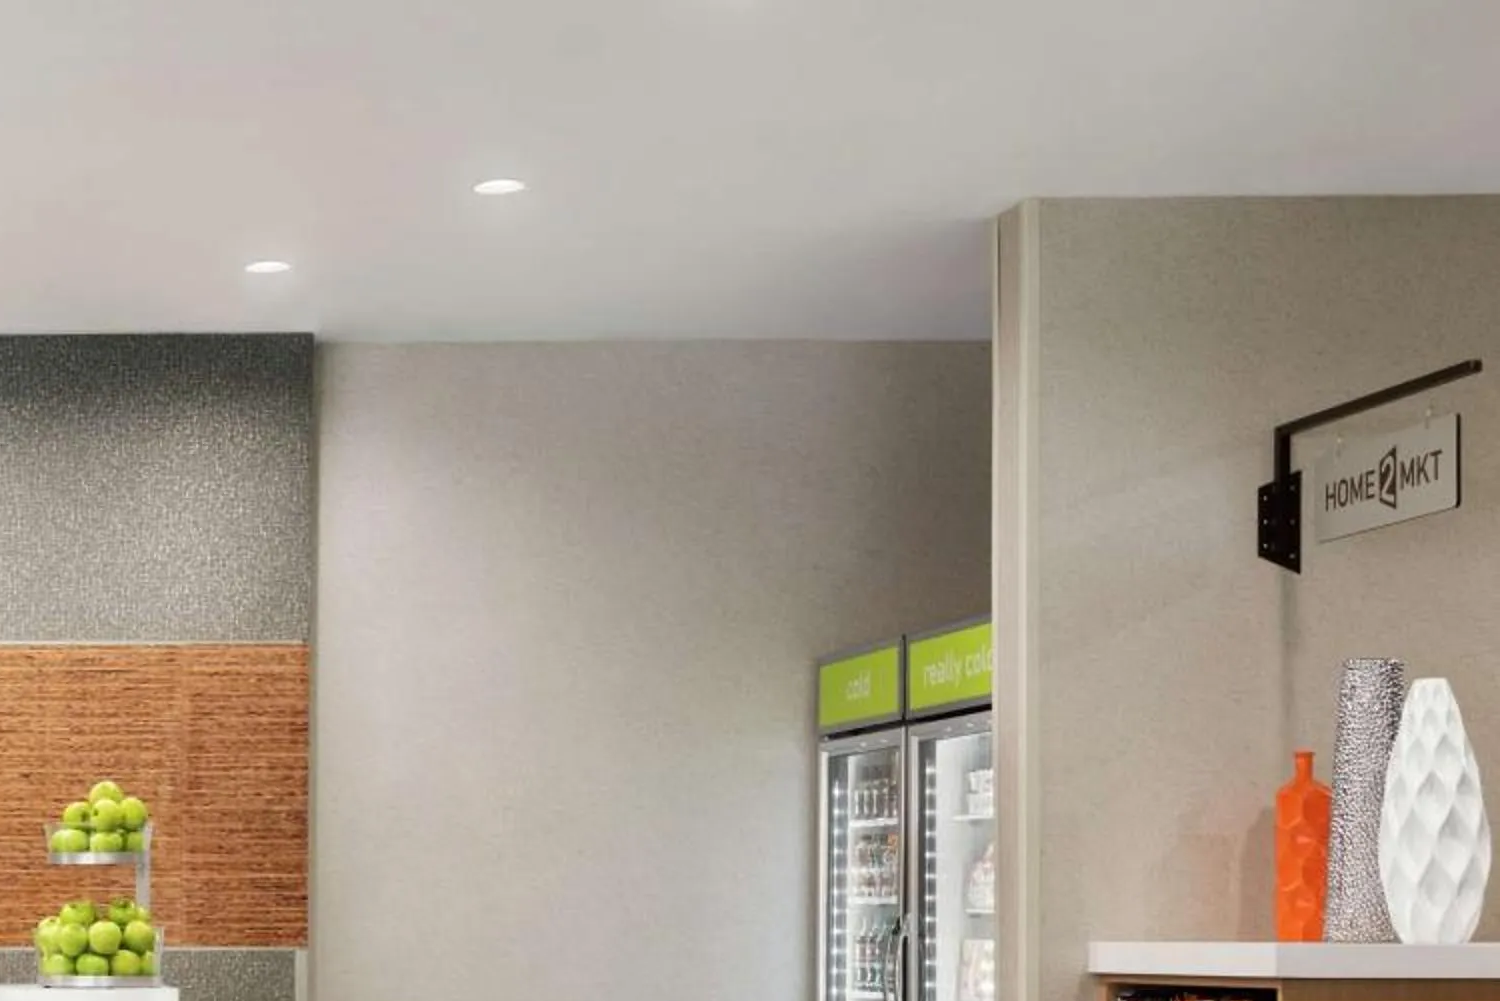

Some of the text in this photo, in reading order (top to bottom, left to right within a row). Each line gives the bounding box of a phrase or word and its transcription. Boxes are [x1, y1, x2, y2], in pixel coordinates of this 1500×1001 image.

[1400, 449, 1443, 490] MKT
[846, 669, 871, 700] cold
[923, 649, 962, 689] really
